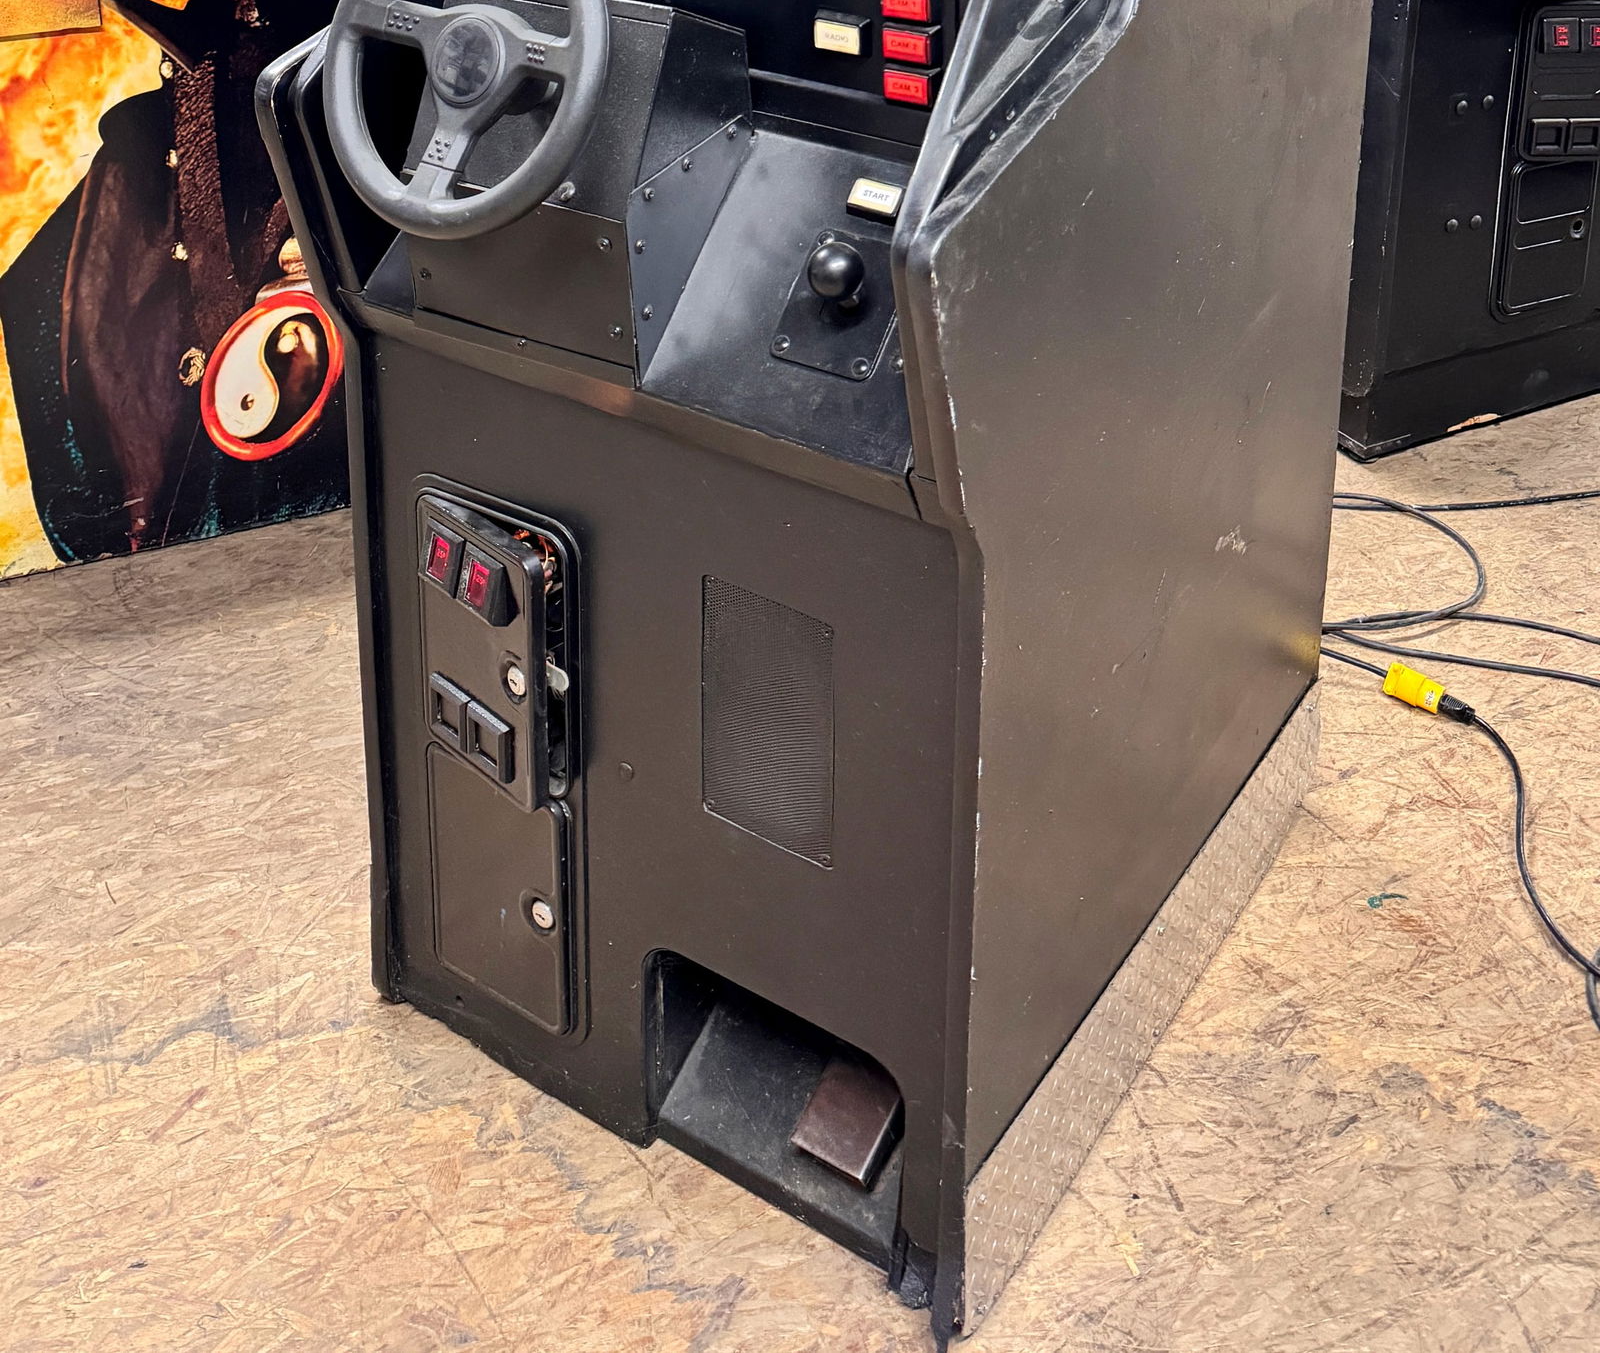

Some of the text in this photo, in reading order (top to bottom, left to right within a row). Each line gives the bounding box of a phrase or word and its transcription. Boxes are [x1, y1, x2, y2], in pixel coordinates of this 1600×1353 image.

[890, 40, 909, 49] CAM
[892, 82, 911, 92] CAM
[863, 189, 890, 201] START
